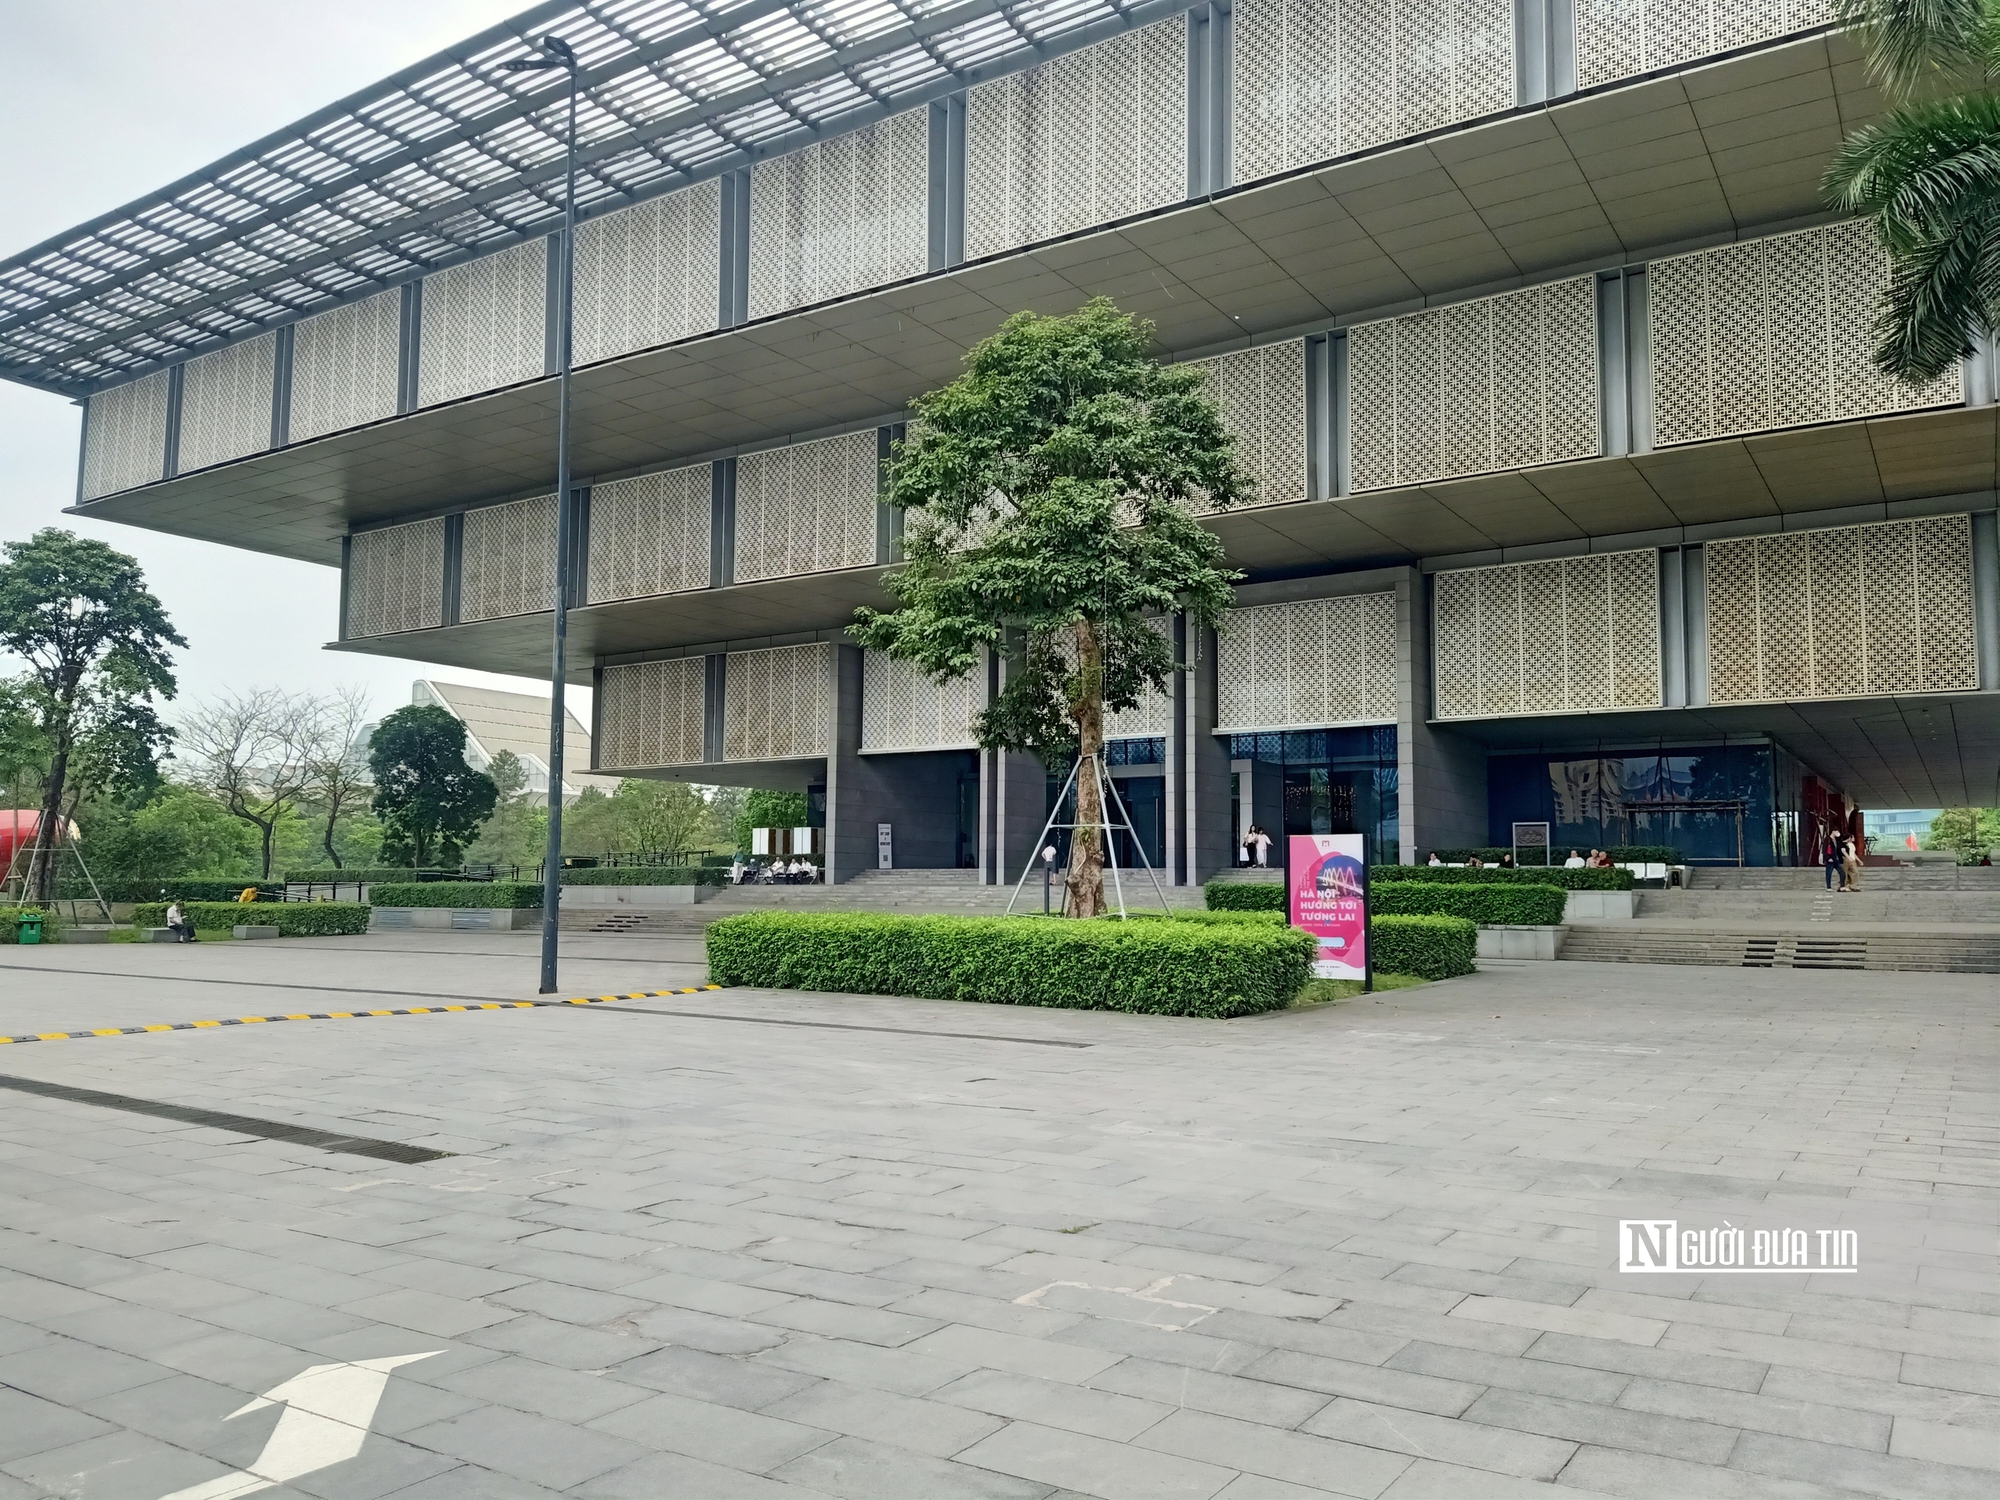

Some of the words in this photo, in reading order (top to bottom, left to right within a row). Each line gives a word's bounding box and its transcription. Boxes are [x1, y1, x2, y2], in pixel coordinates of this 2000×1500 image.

[1300, 888, 1315, 899] HÀ
[1317, 888, 1336, 900] NỘI
[1300, 900, 1337, 910] HƯỚNG
[1339, 900, 1357, 910] TỚI
[1300, 911, 1336, 921] TƯƠNG
[1338, 913, 1355, 921] LAI
